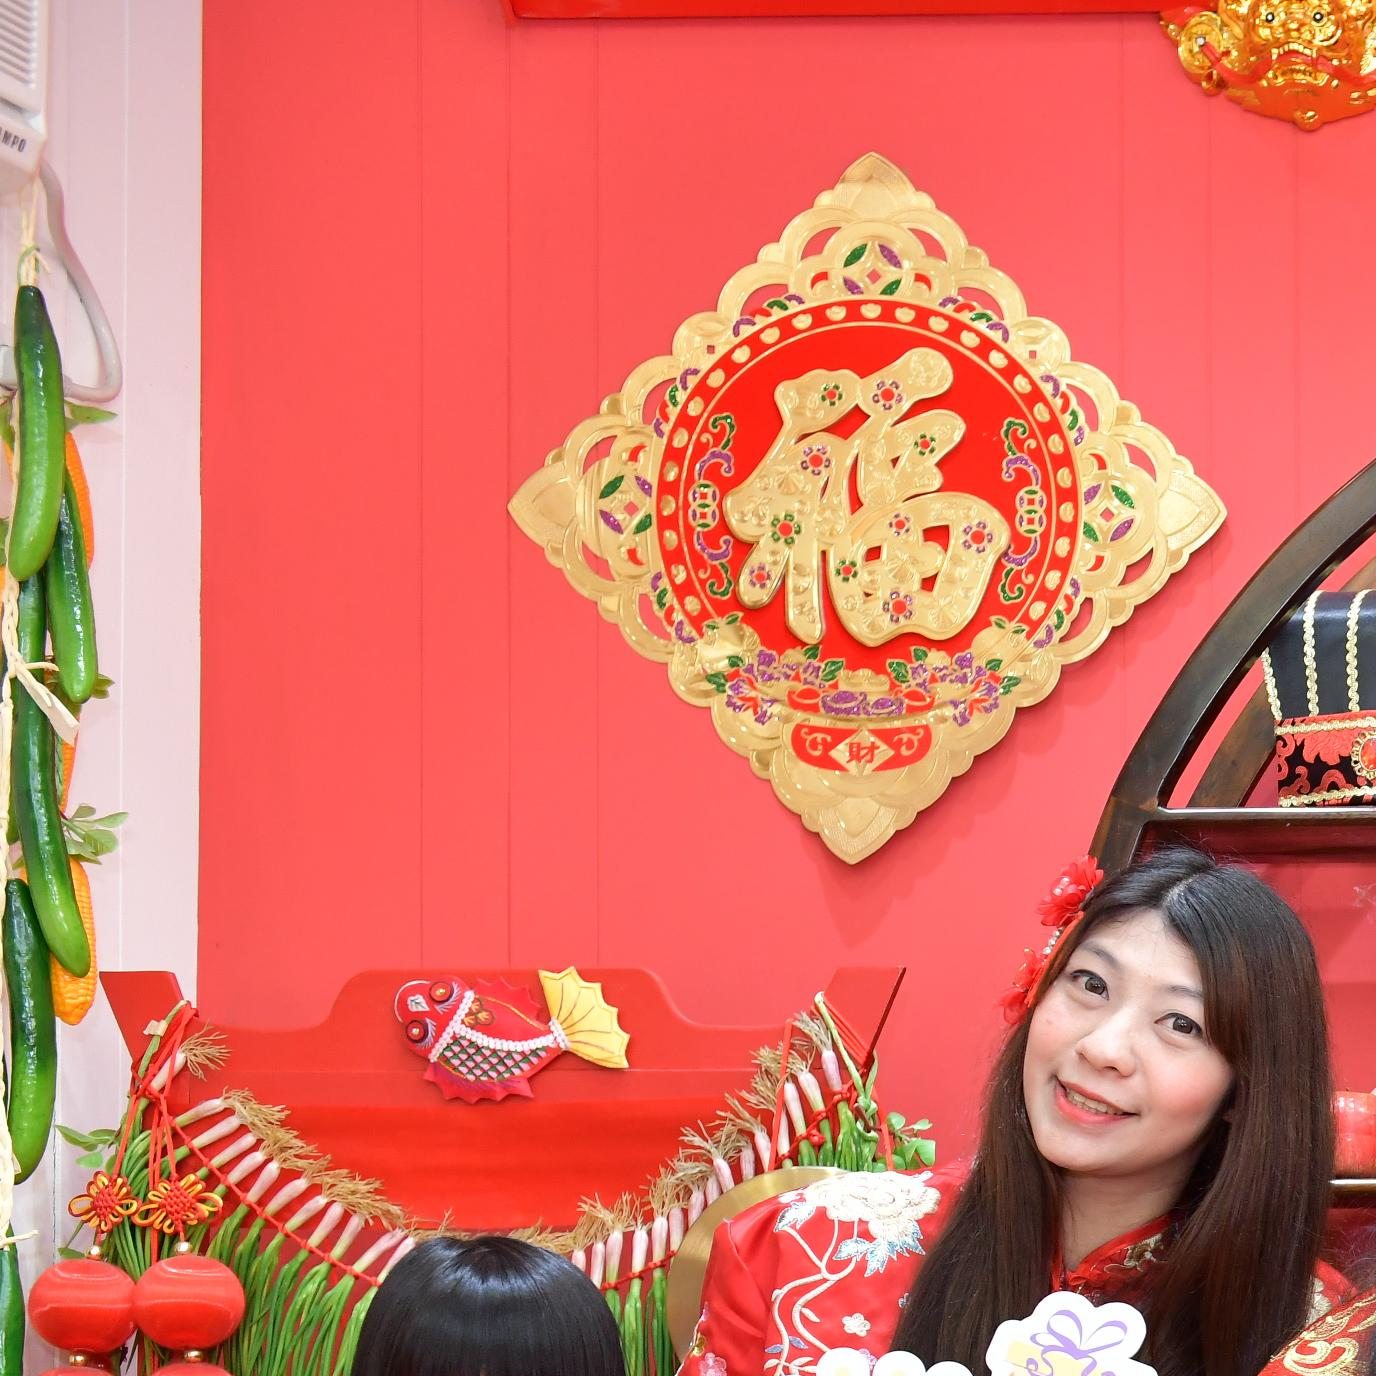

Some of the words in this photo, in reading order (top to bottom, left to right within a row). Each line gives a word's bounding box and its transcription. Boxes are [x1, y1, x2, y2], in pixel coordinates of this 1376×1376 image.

[0, 126, 27, 153] MPO
[722, 347, 1010, 648] 福
[846, 738, 881, 765] 財
